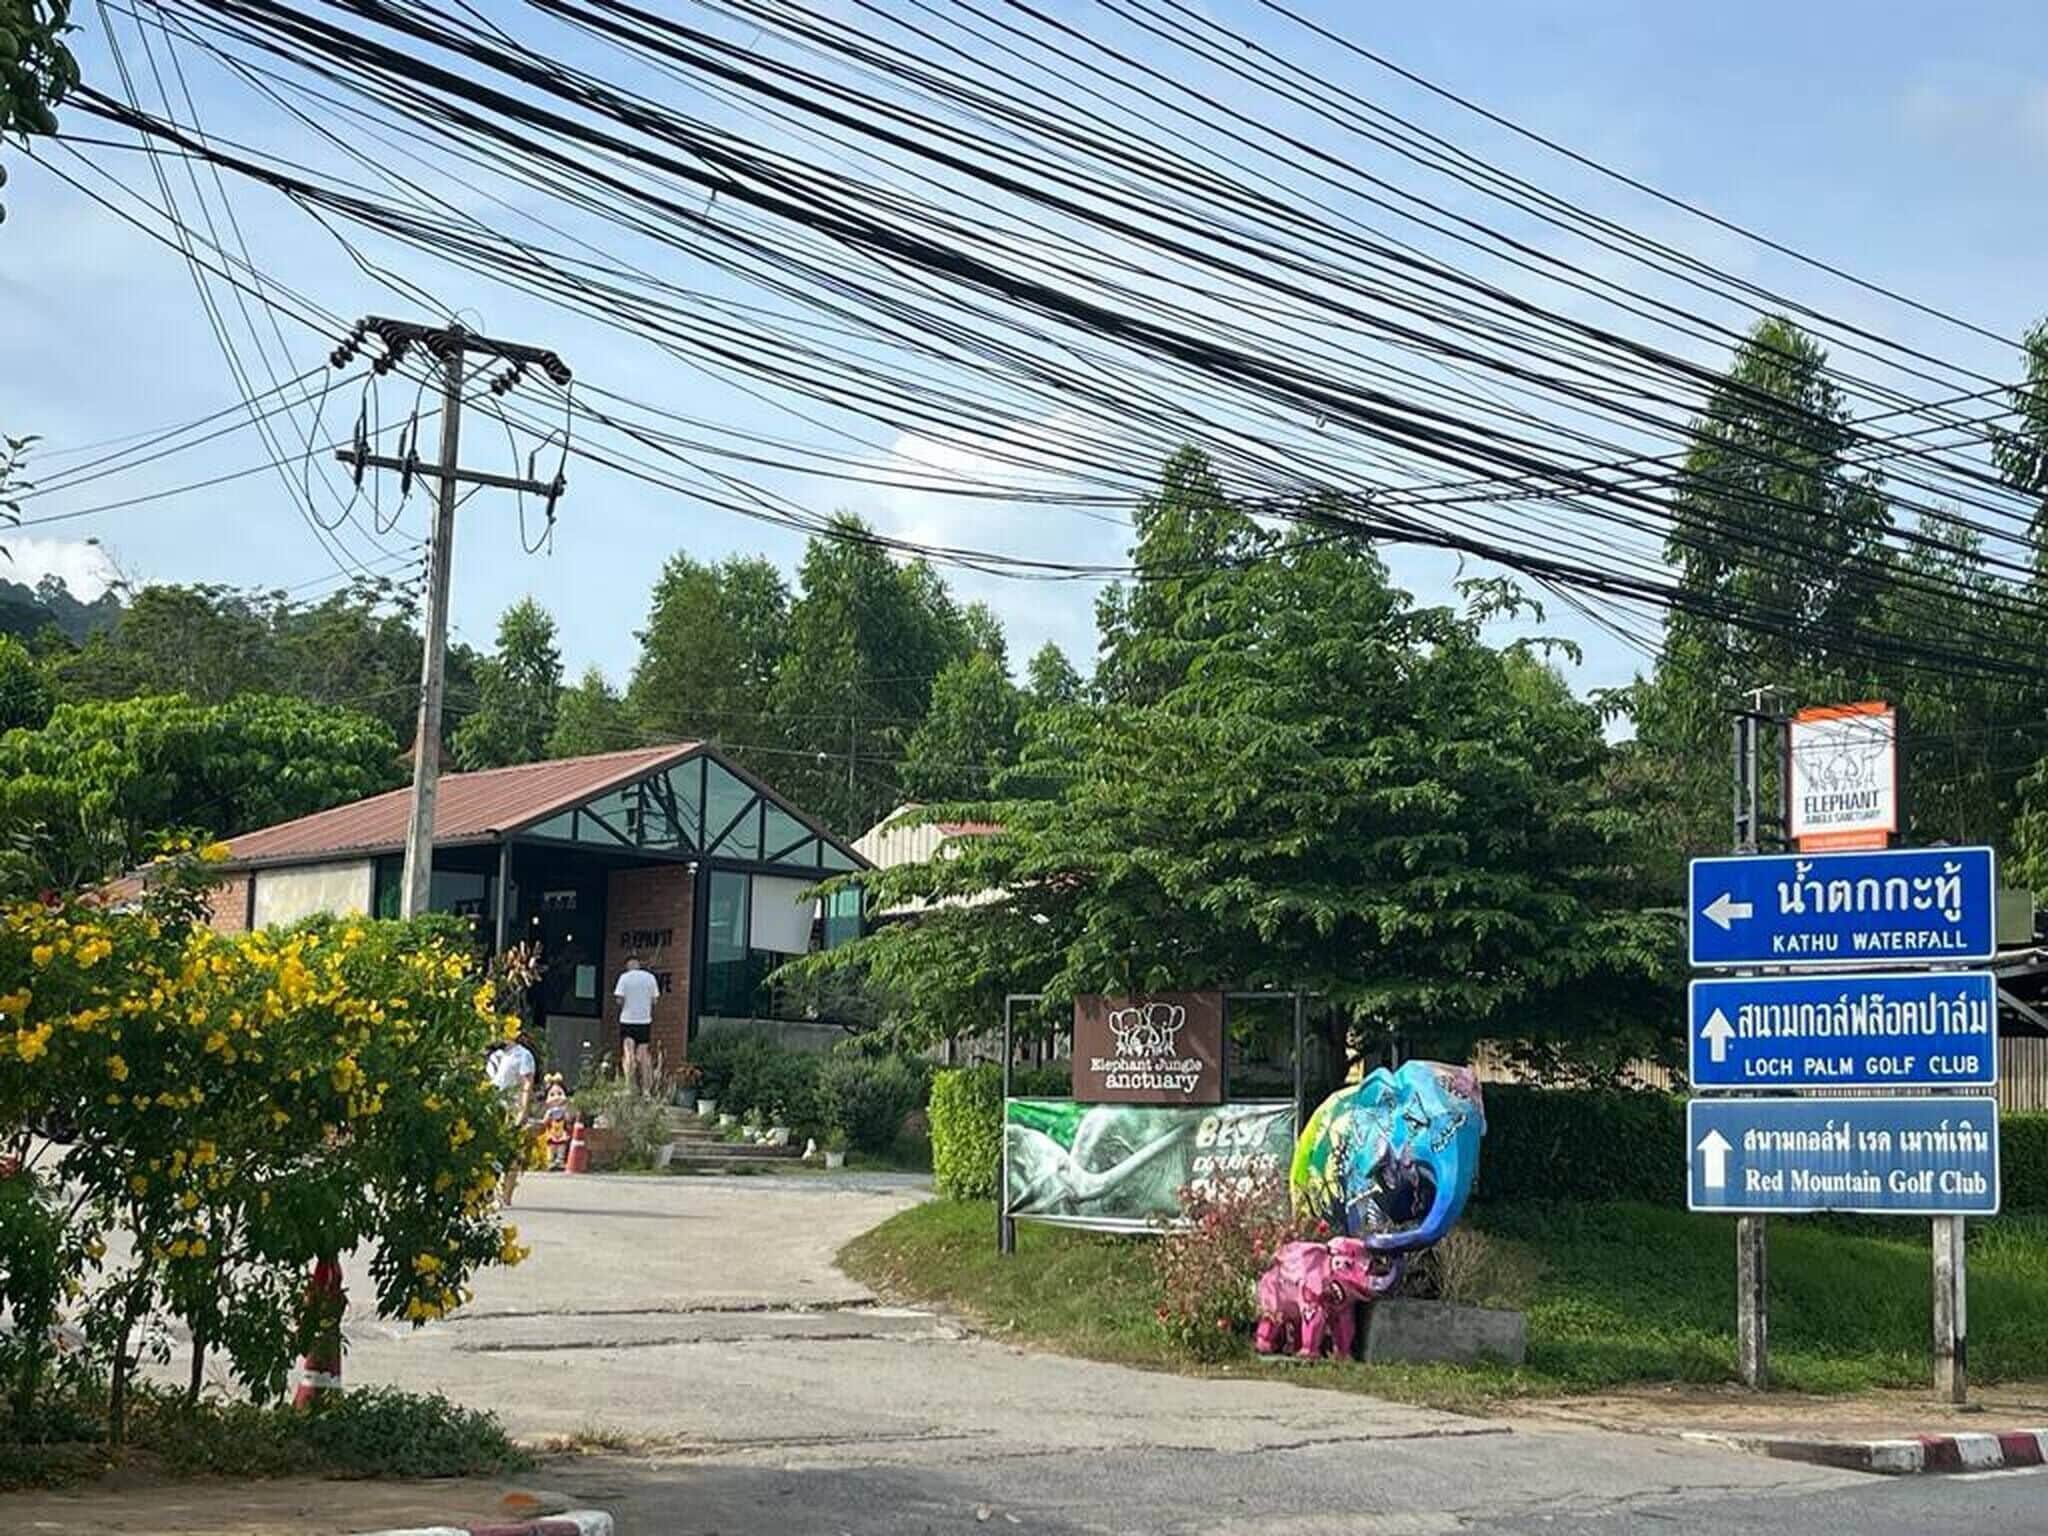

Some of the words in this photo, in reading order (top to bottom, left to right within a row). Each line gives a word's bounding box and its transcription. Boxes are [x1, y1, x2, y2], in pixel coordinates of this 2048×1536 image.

[1803, 790, 1879, 813] ELEPHANT
[1777, 861, 1963, 922] น้ำตกกะทู้
[1773, 934, 1838, 952] KATHU
[1853, 931, 1968, 950] WATERFALL
[1090, 1058, 1153, 1072] Elephant
[1154, 1058, 1203, 1073] Jungle
[1745, 1059, 1793, 1077] LOCH
[1804, 1058, 1853, 1075] PALM
[1866, 1057, 1915, 1074] GOLF
[1930, 1056, 1979, 1073] CLUB
[1105, 1071, 1200, 1093] anctuary
[1195, 1116, 1269, 1149] BEST
[1743, 1120, 1850, 1152] สนามกอล์ฟ
[1745, 1168, 1783, 1192] Red
[1791, 1169, 1881, 1193] Mountain
[1889, 1170, 1934, 1193] Golf
[1939, 1170, 1987, 1194] Club
